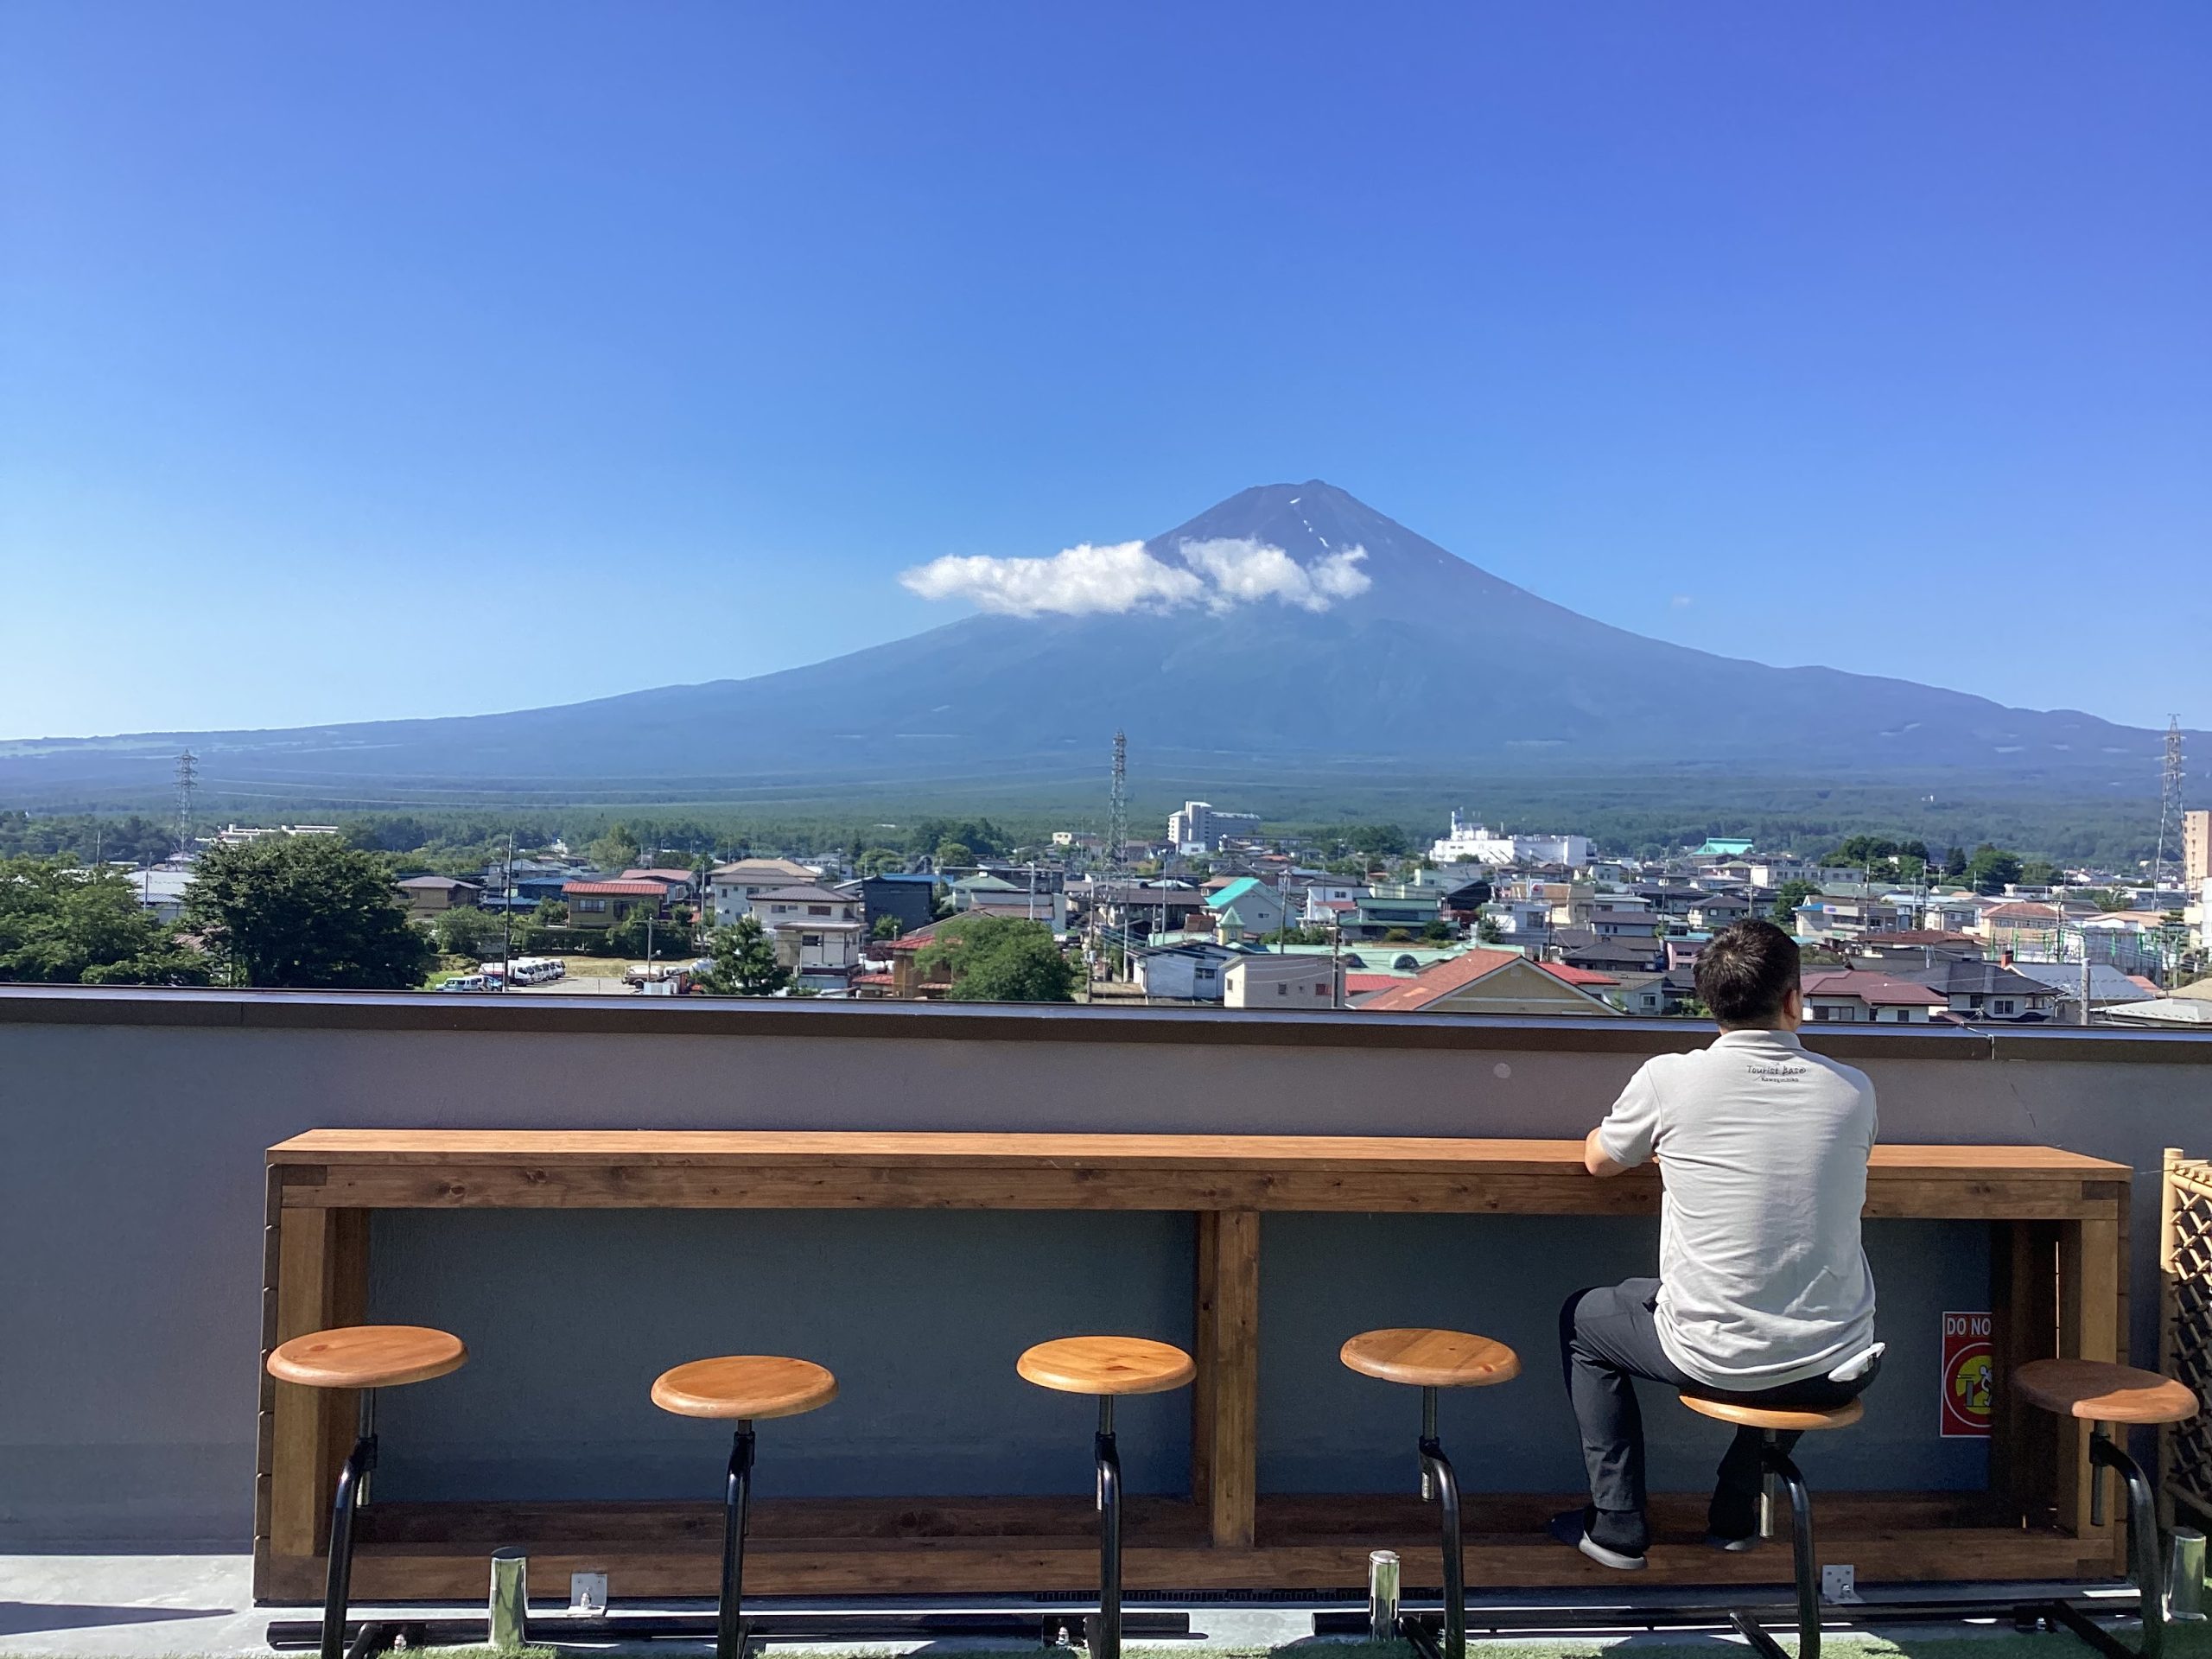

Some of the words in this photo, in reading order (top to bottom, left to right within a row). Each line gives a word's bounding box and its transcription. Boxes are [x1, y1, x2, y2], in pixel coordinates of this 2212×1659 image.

[1747, 1065, 1778, 1074] Tourist
[1947, 1317, 1967, 1335] DO
[1971, 1317, 1992, 1336] NO
